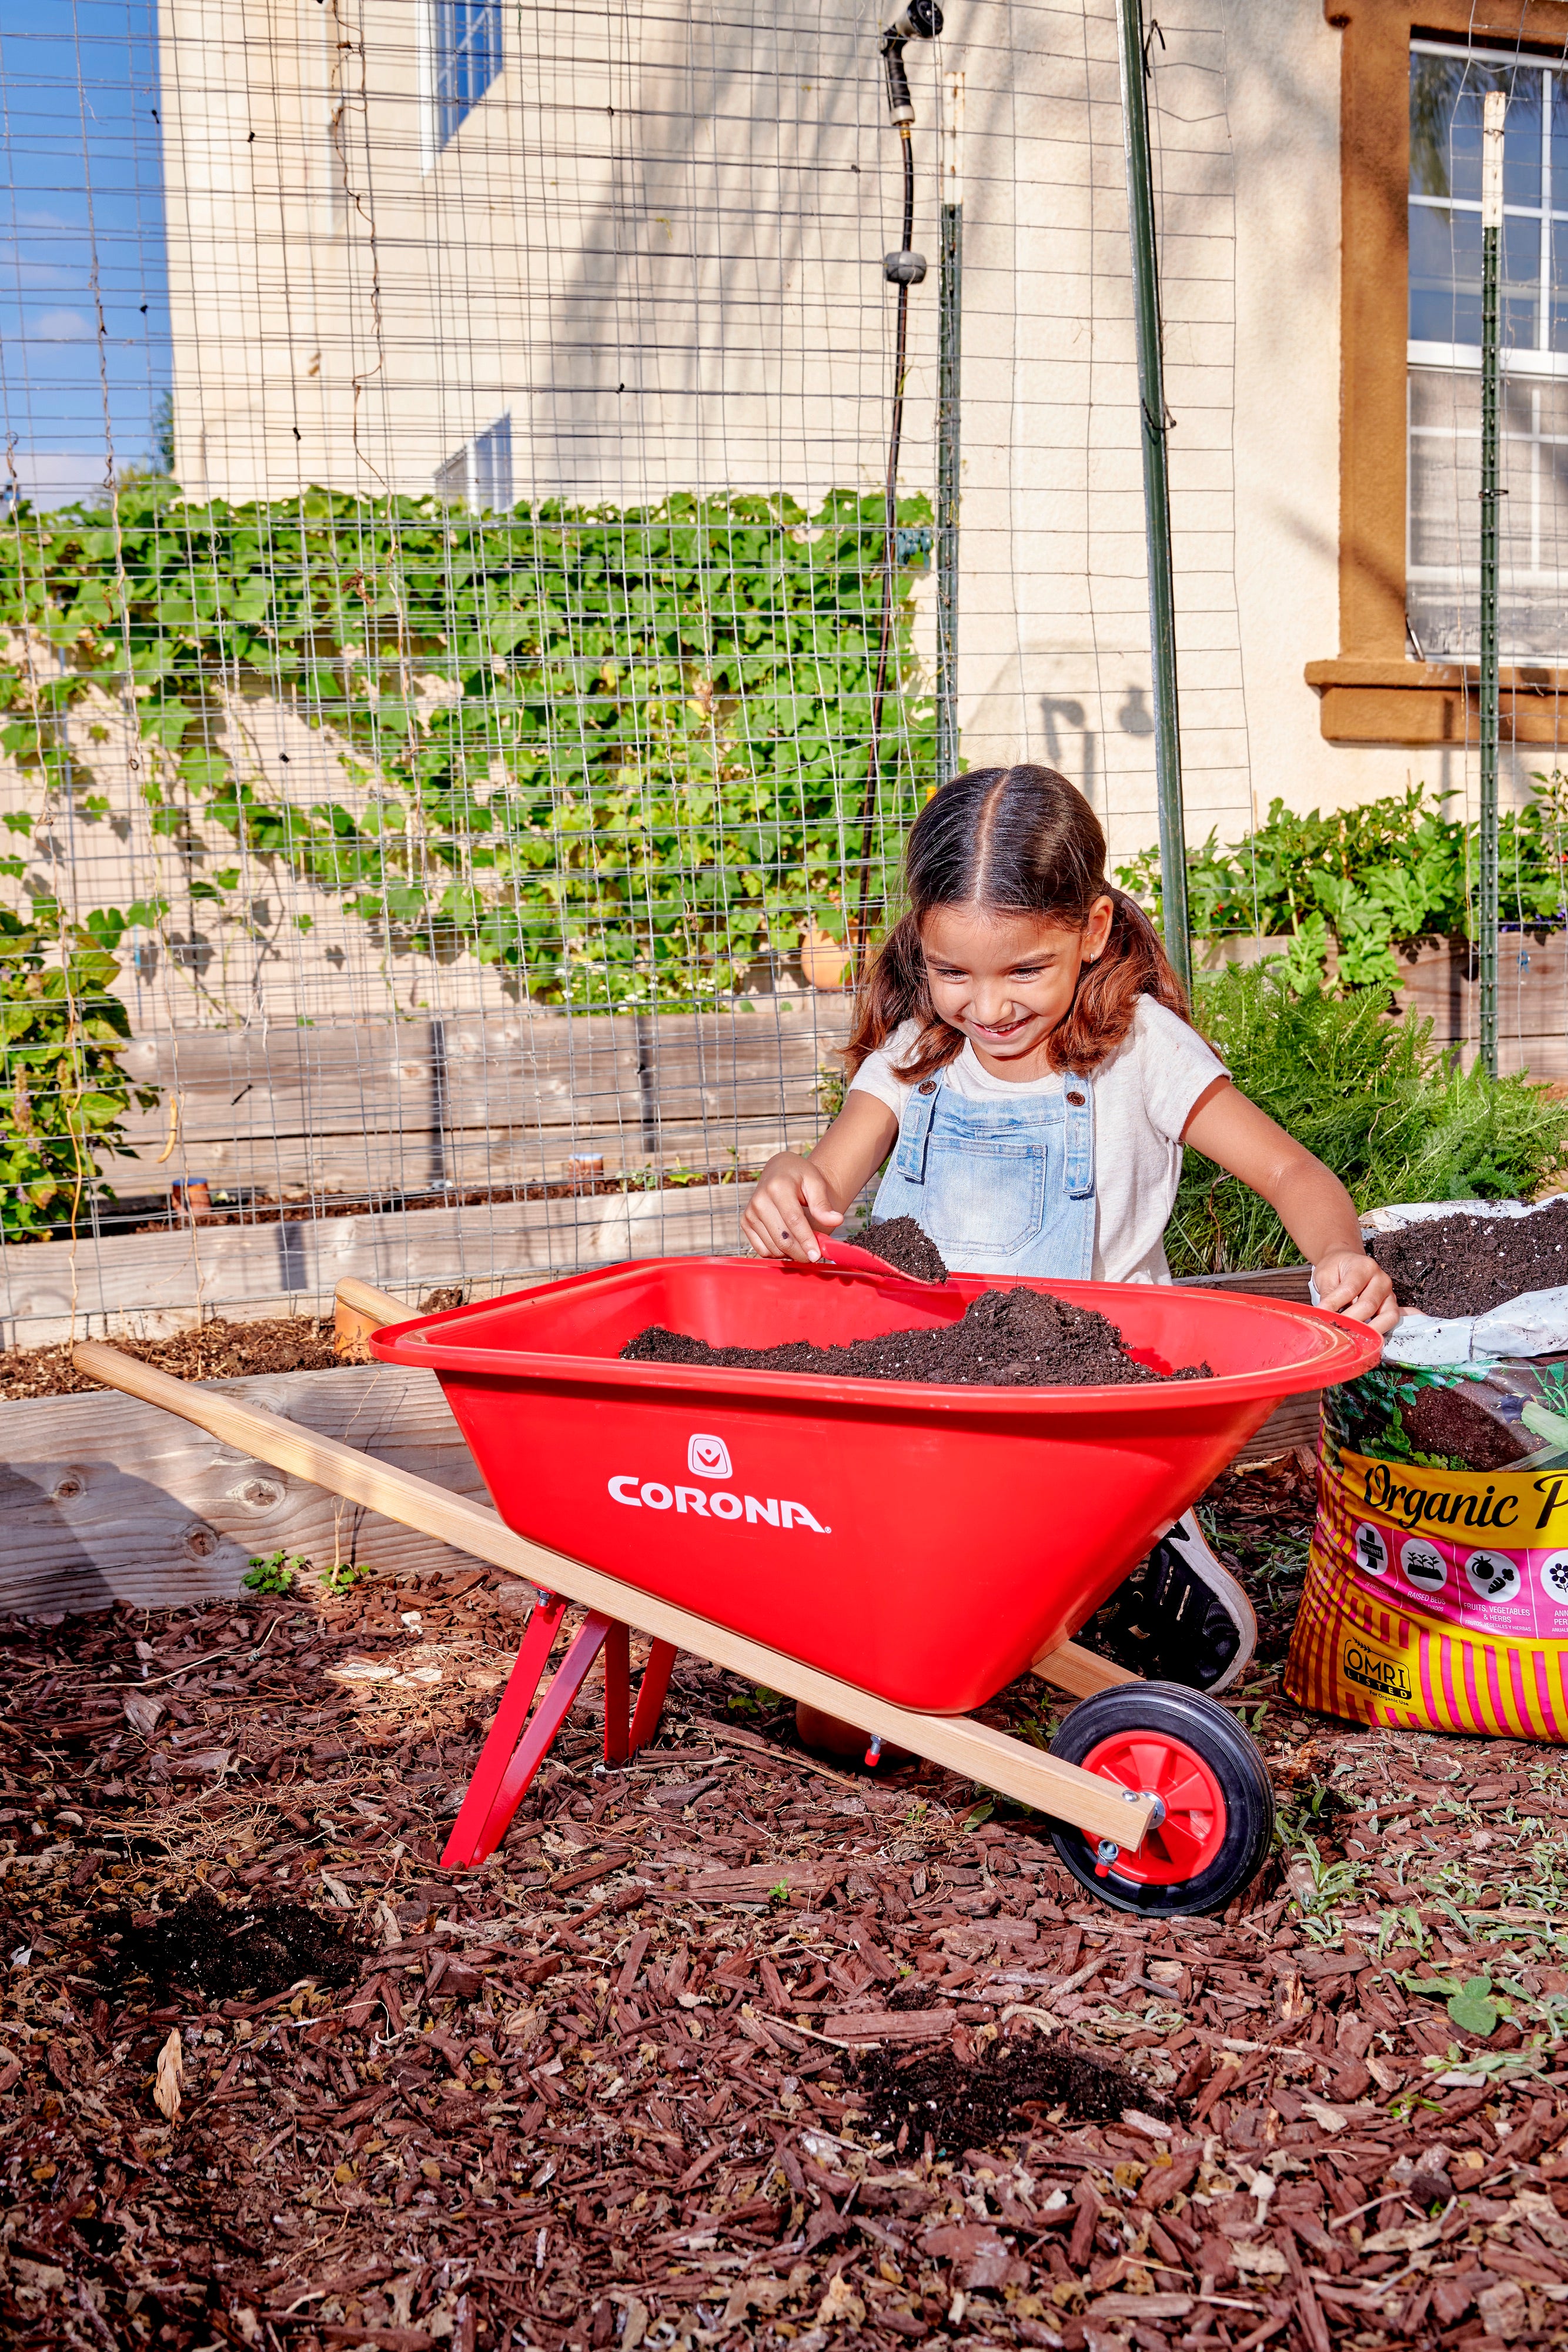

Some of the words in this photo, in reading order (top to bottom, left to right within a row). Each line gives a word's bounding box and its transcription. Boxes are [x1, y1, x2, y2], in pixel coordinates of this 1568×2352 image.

[1364, 1464, 1519, 1529] Organic
[1360, 1544, 1382, 1556] NUTRIENTS
[1407, 1591, 1429, 1602] RAISED
[1430, 1596, 1446, 1605] BEDS
[1489, 1606, 1530, 1616] VEGETABLES
[1489, 1615, 1512, 1623] HERBS
[1347, 1648, 1406, 1689] OMRI
[1348, 1670, 1407, 1698] LISTED
[1378, 1693, 1398, 1703] Organic
